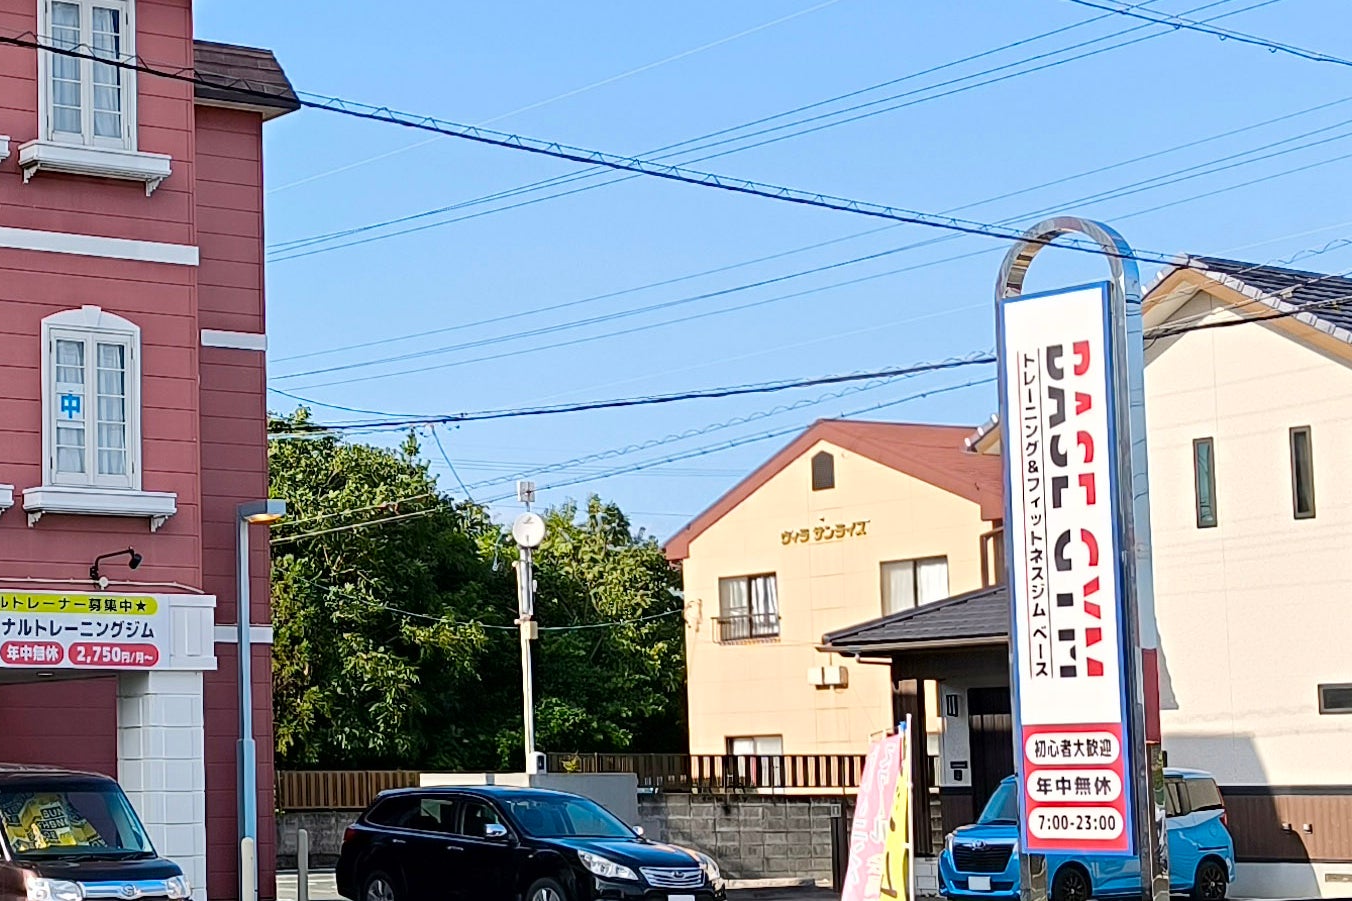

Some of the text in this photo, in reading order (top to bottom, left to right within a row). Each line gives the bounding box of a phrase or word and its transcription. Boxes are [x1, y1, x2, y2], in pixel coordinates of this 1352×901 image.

[60, 393, 82, 419] 中
[7, 645, 59, 661] 年中無休
[1032, 626, 1048, 677] ベース
[1034, 738, 1112, 759] 初心者大歓迎
[1036, 776, 1112, 796] 年中無休
[1038, 815, 1116, 831] 7:00-23:00
